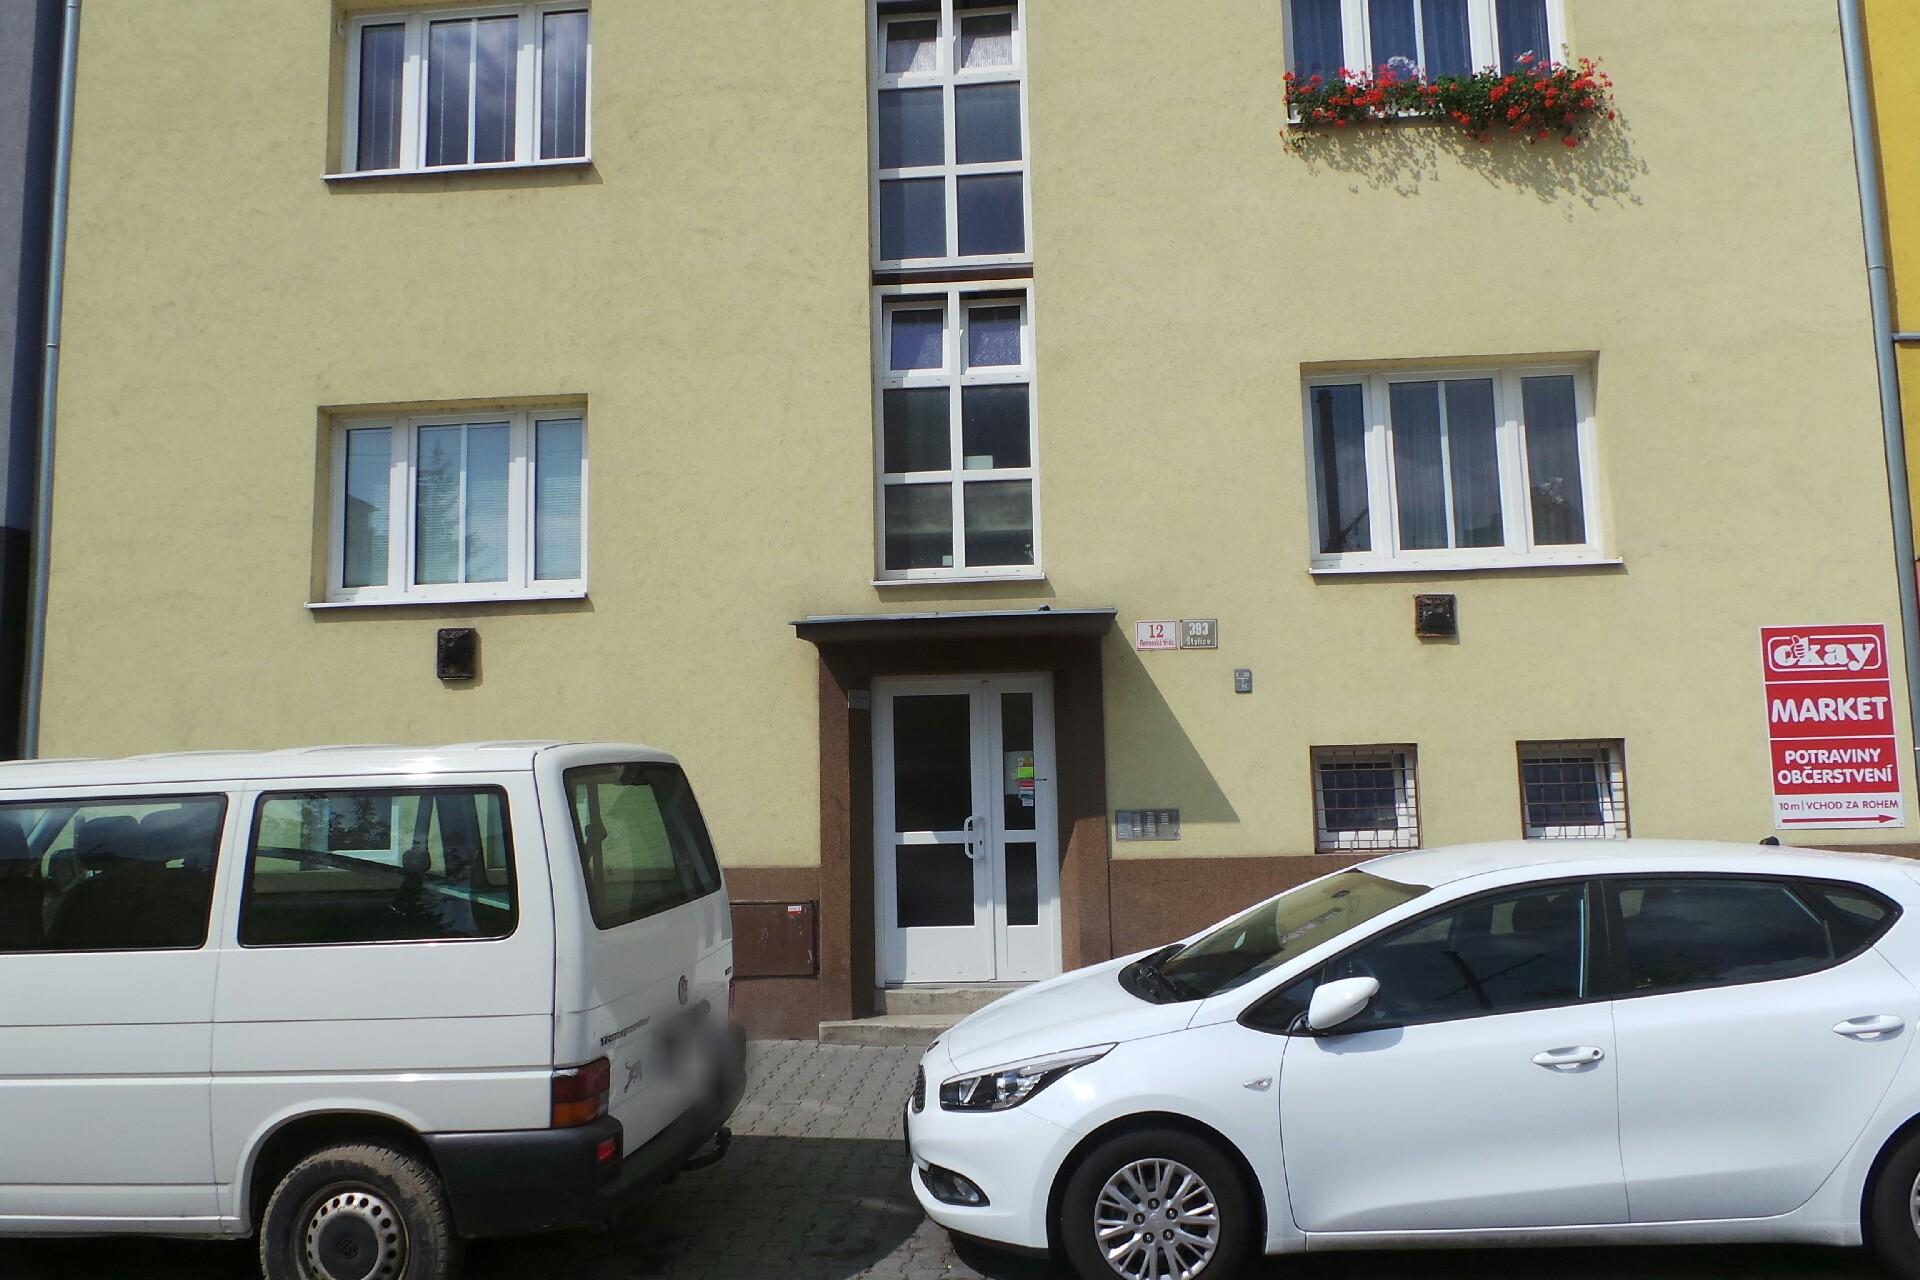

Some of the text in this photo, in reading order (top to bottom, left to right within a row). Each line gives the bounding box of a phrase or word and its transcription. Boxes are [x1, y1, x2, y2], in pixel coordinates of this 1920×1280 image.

[1149, 624, 1164, 639] 12
[1189, 622, 1209, 635] 393
[1771, 696, 1888, 723] MARKET
[1785, 748, 1881, 764] POTRAVINY
[1777, 764, 1893, 785] OBČERSTVENÍ
[1779, 802, 1789, 811] 10
[1806, 801, 1843, 810] VCHOD
[1846, 801, 1859, 809] ZA
[1862, 800, 1899, 809] ROHEM
